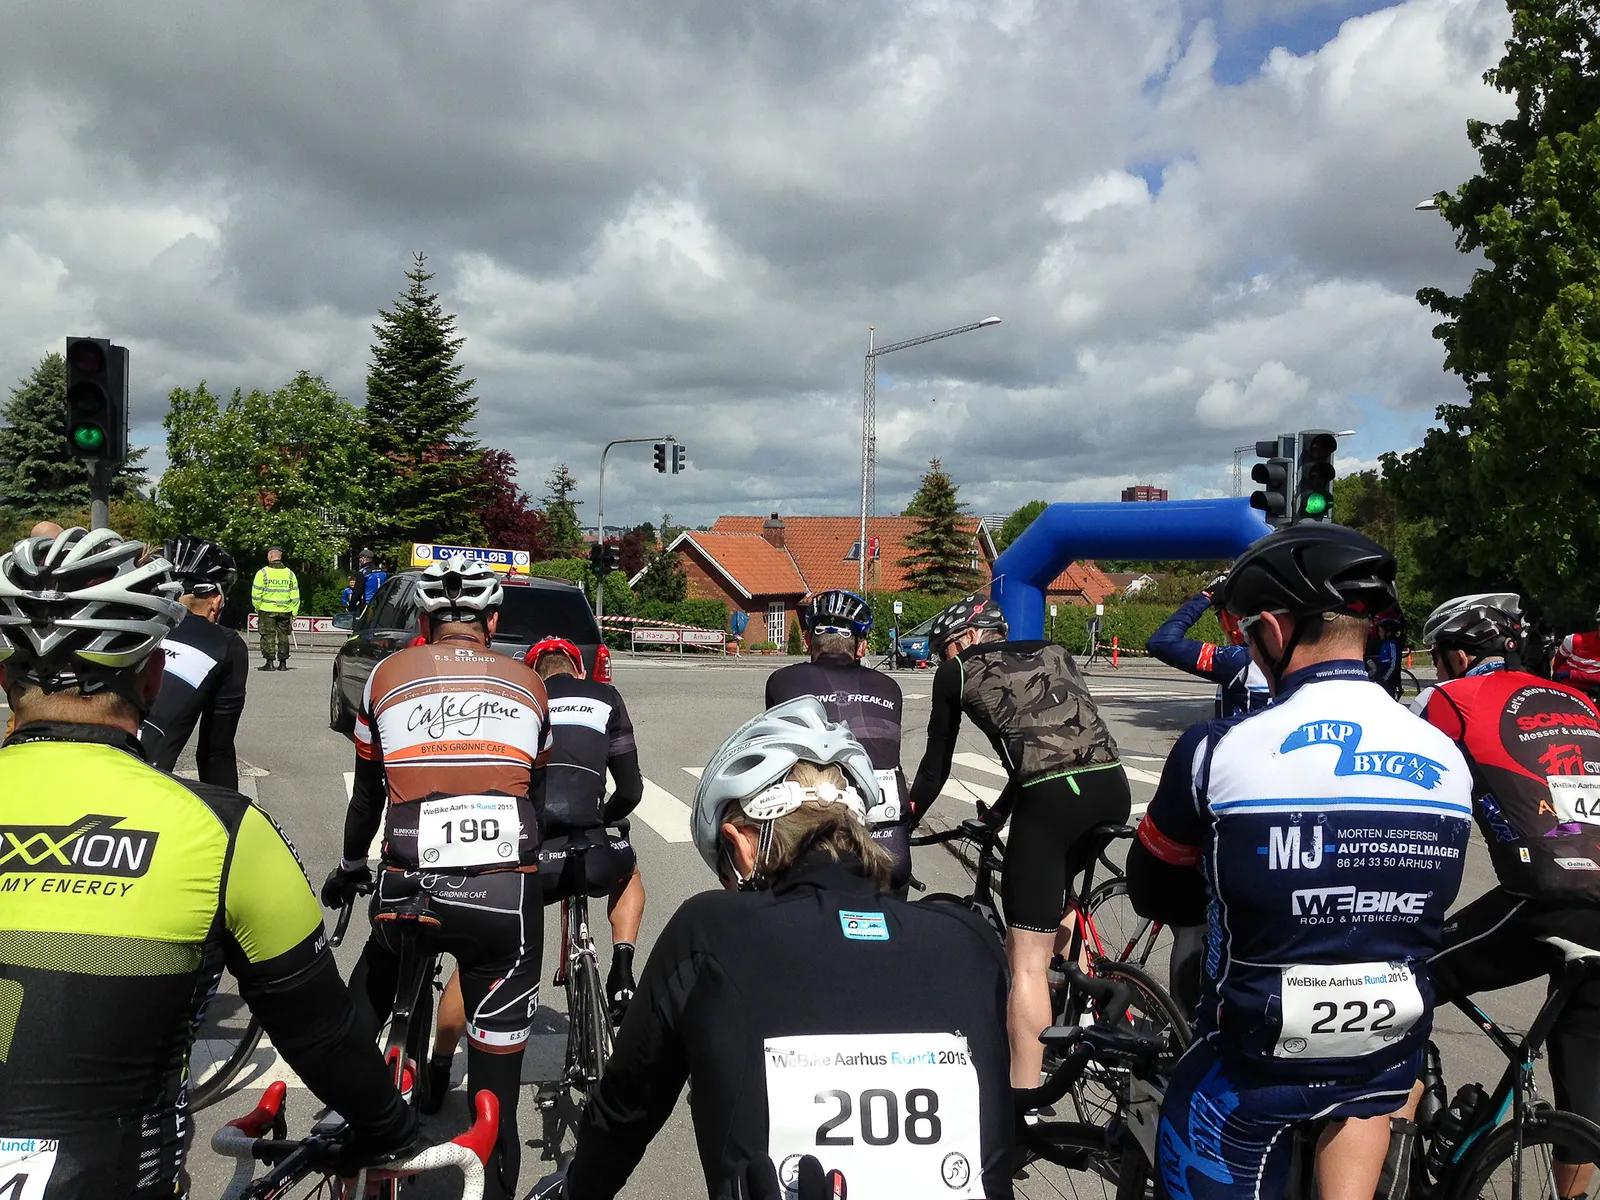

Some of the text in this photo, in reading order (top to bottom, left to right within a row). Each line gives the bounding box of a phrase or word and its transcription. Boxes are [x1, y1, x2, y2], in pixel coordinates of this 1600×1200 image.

[439, 548, 507, 563] CYKELLØB
[1522, 687, 1546, 697] show
[1548, 688, 1568, 698] the
[847, 694, 895, 710] FREAK.DK
[1302, 723, 1354, 743] TKP
[1518, 728, 1560, 742] Messer
[421, 743, 448, 754] BYENS
[449, 743, 485, 751] GRØNNE
[1353, 754, 1428, 782] BYG A/S
[423, 806, 449, 815] WeBike
[497, 803, 514, 811] 2015
[441, 818, 500, 844] 190
[1337, 828, 1438, 842] MORTEN JESPERSEN
[1268, 825, 1324, 870] MJ
[1337, 842, 1460, 859] AUTOSADELMAGER
[1336, 856, 1442, 870] 86 24 33 50 ÅRHUS V.
[1, 877, 134, 897] MY ENERGY
[469, 890, 488, 899] CAFÉ
[1300, 914, 1420, 925] ROAD & MTBIKESHOP
[1287, 972, 1409, 987] WeBike Aarhus Rundt 2015
[1310, 998, 1397, 1035] 222
[834, 1052, 887, 1066] Aarhus
[891, 1051, 936, 1065] Rundt
[938, 1050, 967, 1066] 2015
[814, 1087, 942, 1146] 208
[0, 1139, 36, 1152] undt
